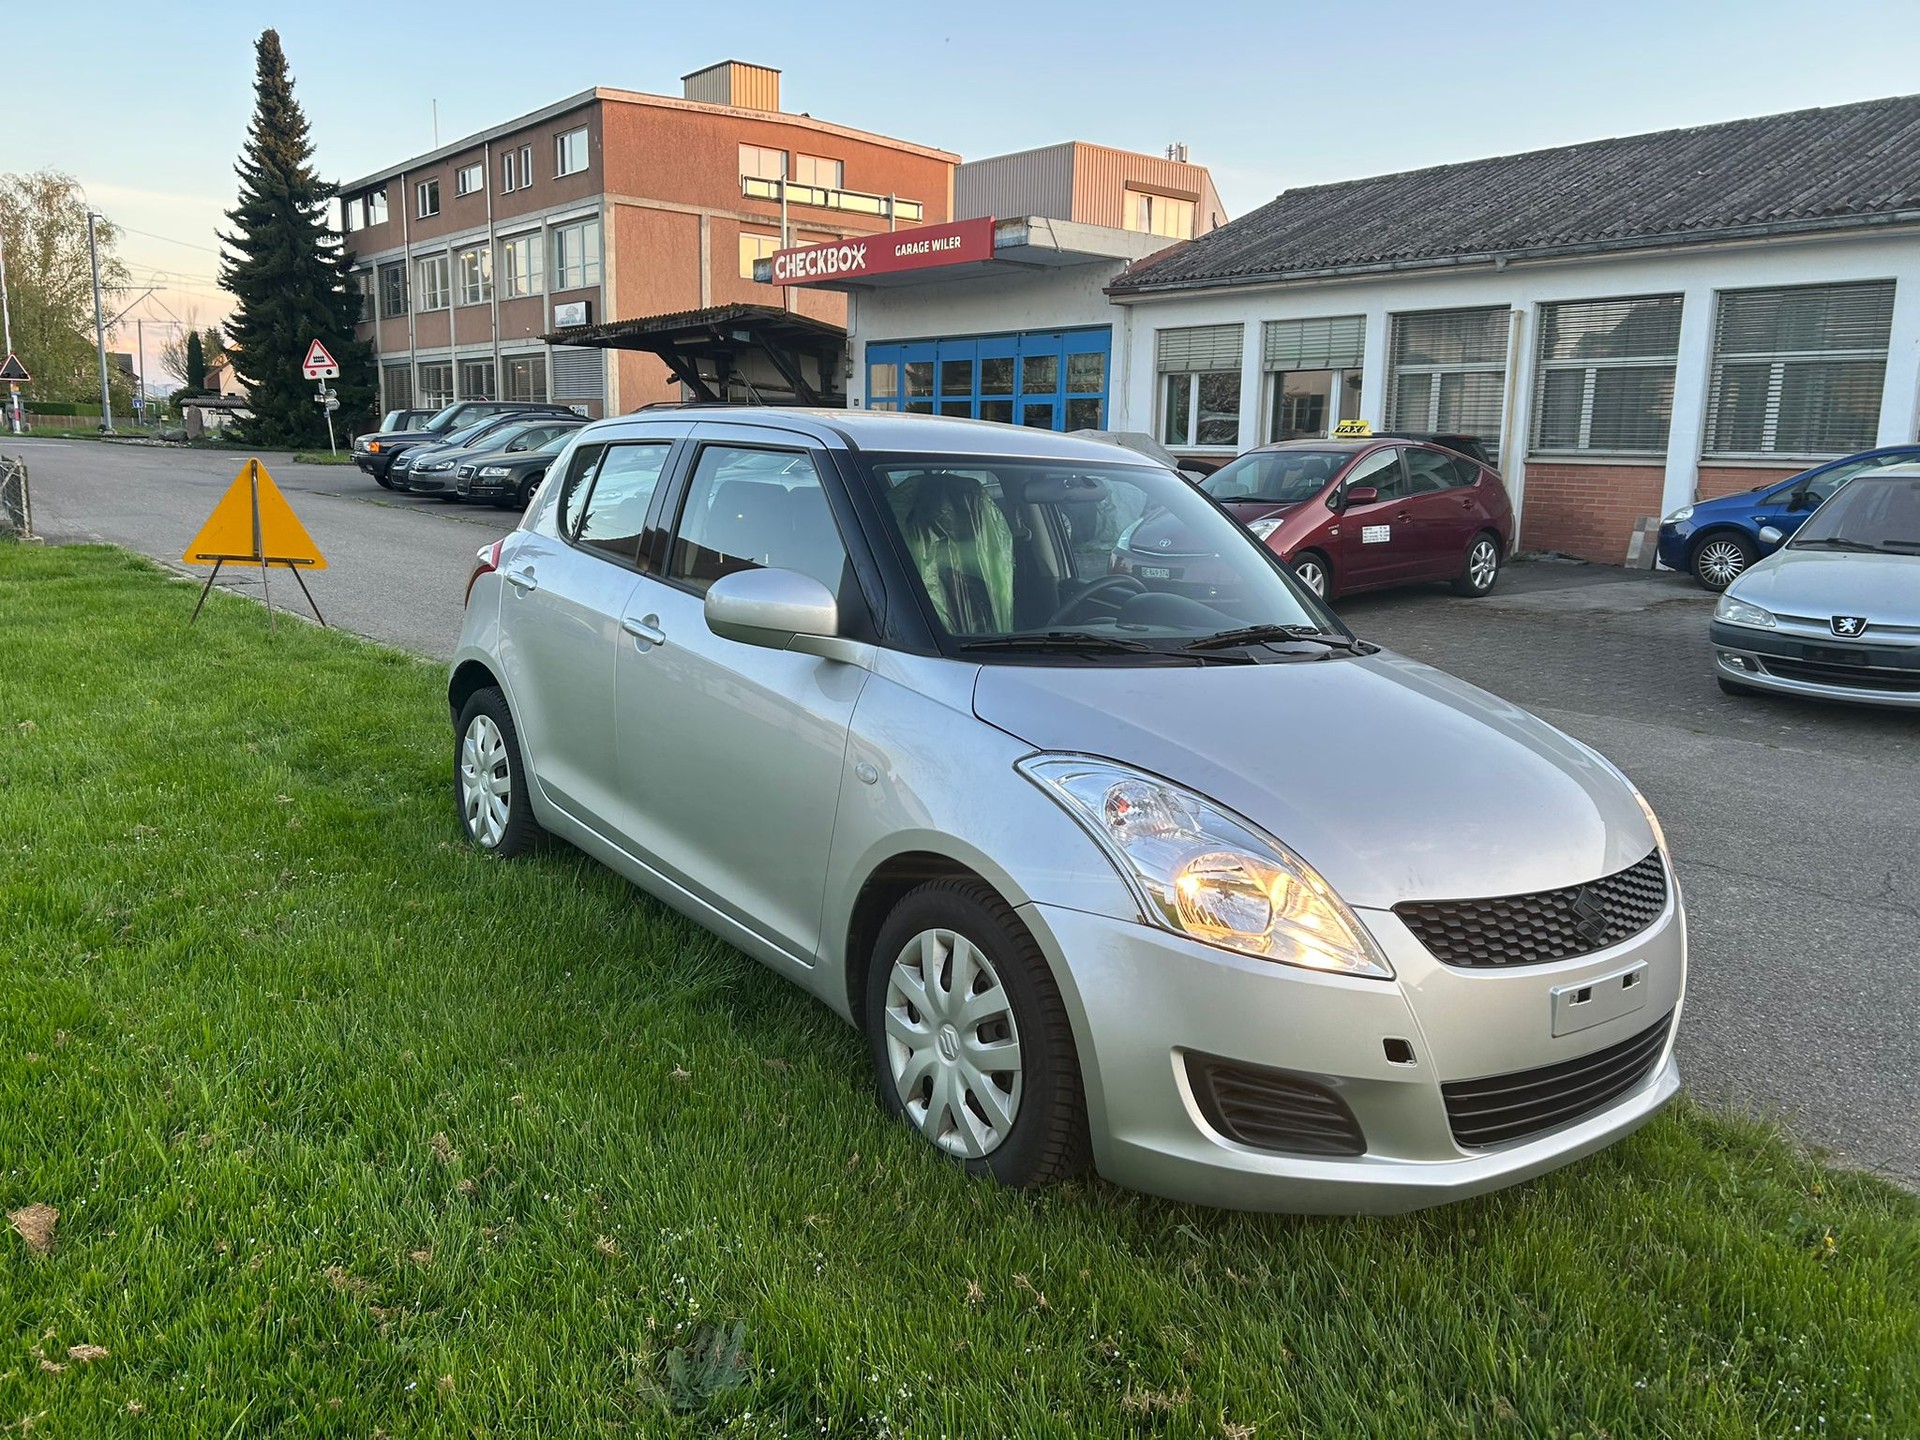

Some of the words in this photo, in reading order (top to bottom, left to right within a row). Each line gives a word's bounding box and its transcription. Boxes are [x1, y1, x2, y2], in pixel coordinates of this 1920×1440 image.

[895, 240, 930, 257] GARAGE
[931, 236, 961, 252] WILER
[774, 242, 867, 279] CHECKBOX
[1338, 425, 1366, 433] TAXI
